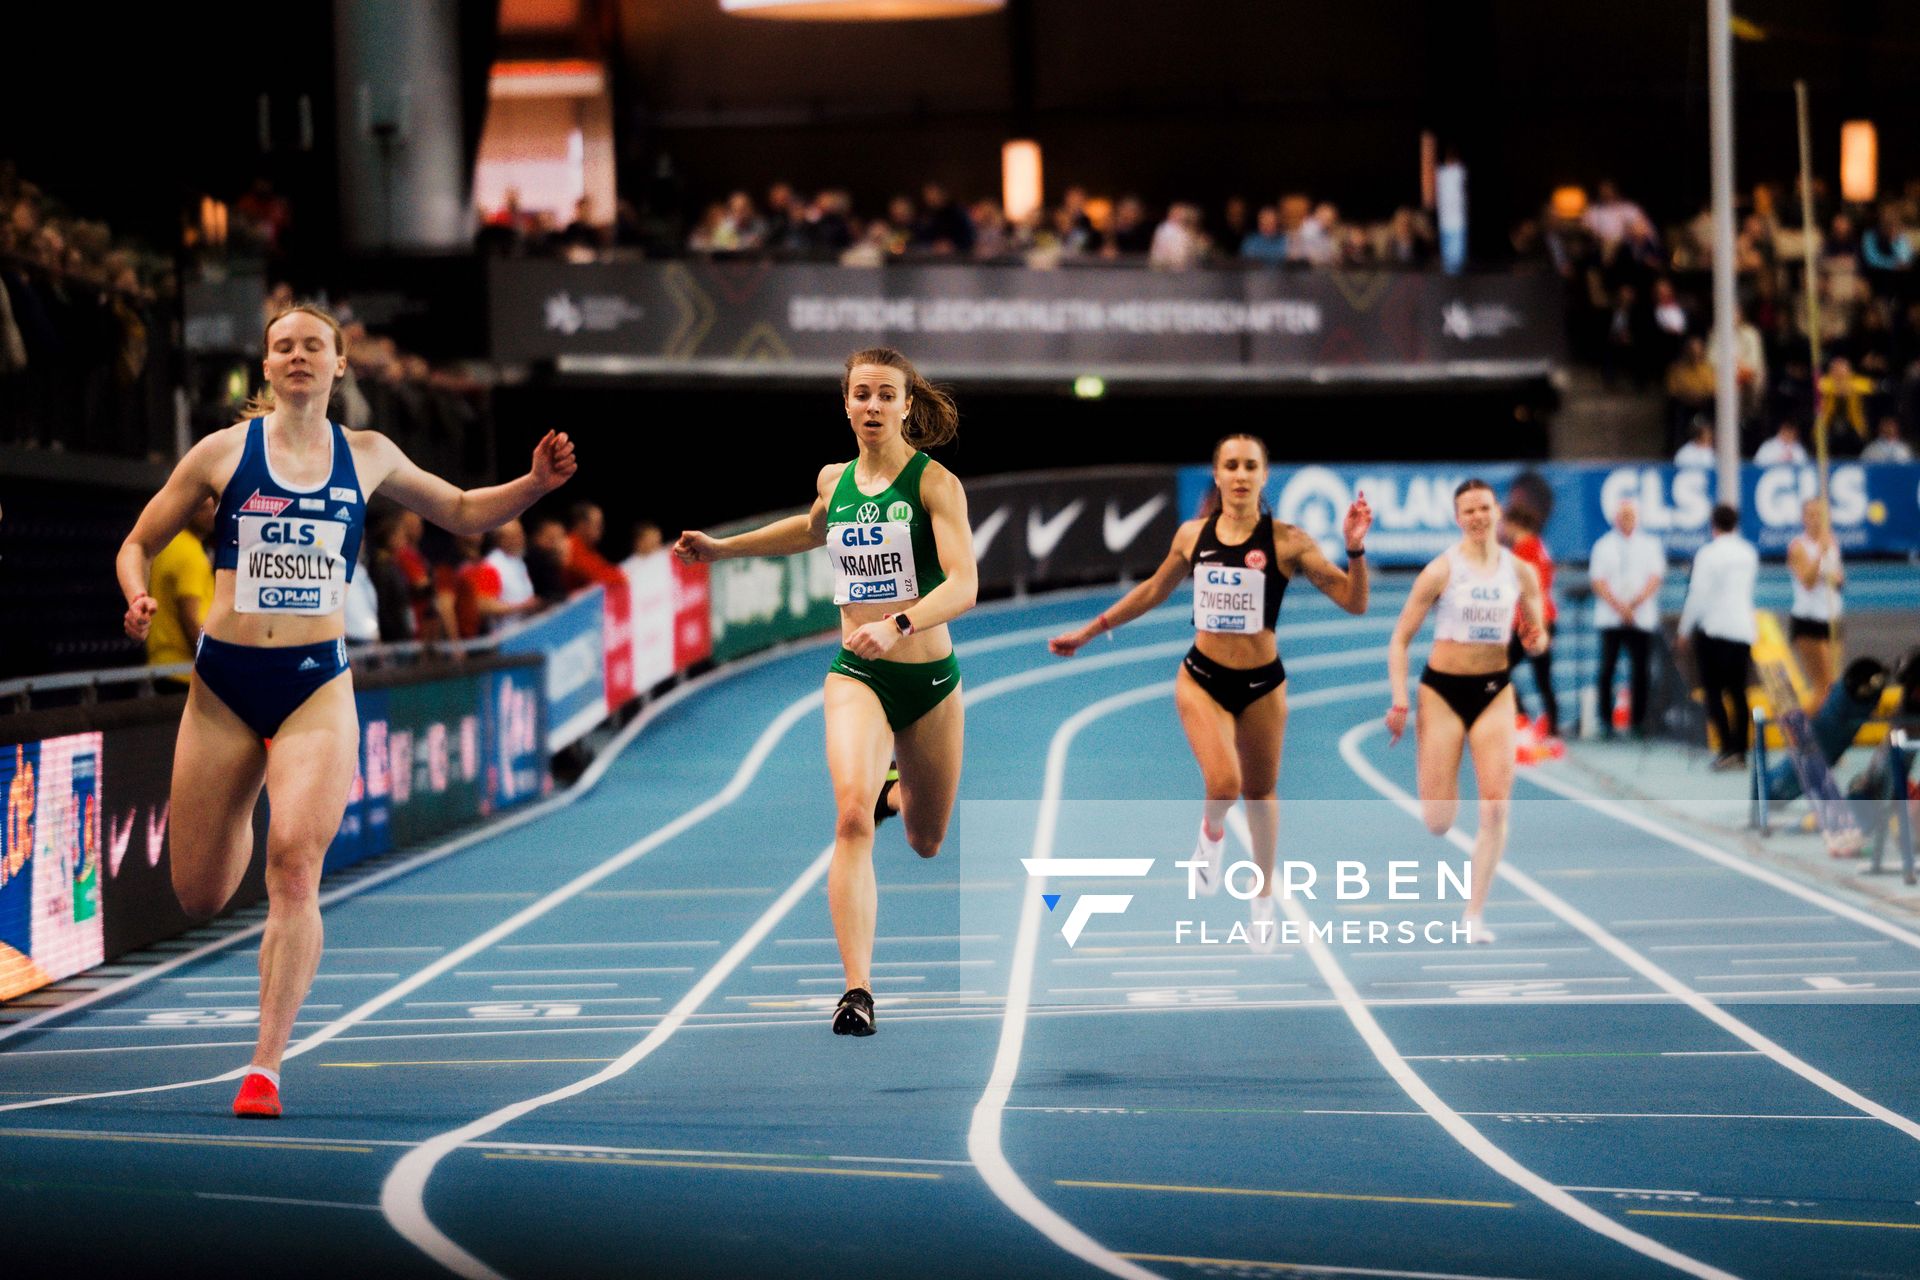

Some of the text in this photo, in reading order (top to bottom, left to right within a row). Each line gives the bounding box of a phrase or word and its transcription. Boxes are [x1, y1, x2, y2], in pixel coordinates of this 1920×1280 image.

[1601, 467, 1711, 528] GLS
[260, 521, 315, 546] GLS
[842, 527, 884, 546] GLS
[249, 552, 335, 580] WESSOLLY
[840, 552, 903, 577] KRAMER
[904, 579, 913, 593] 273
[1207, 570, 1241, 586] GLS
[285, 590, 319, 602] PLAN
[867, 583, 895, 593] PLAN
[1471, 587, 1500, 600] GLS
[1200, 591, 1256, 611] ZWERGEL
[1220, 616, 1244, 625] PLAN
